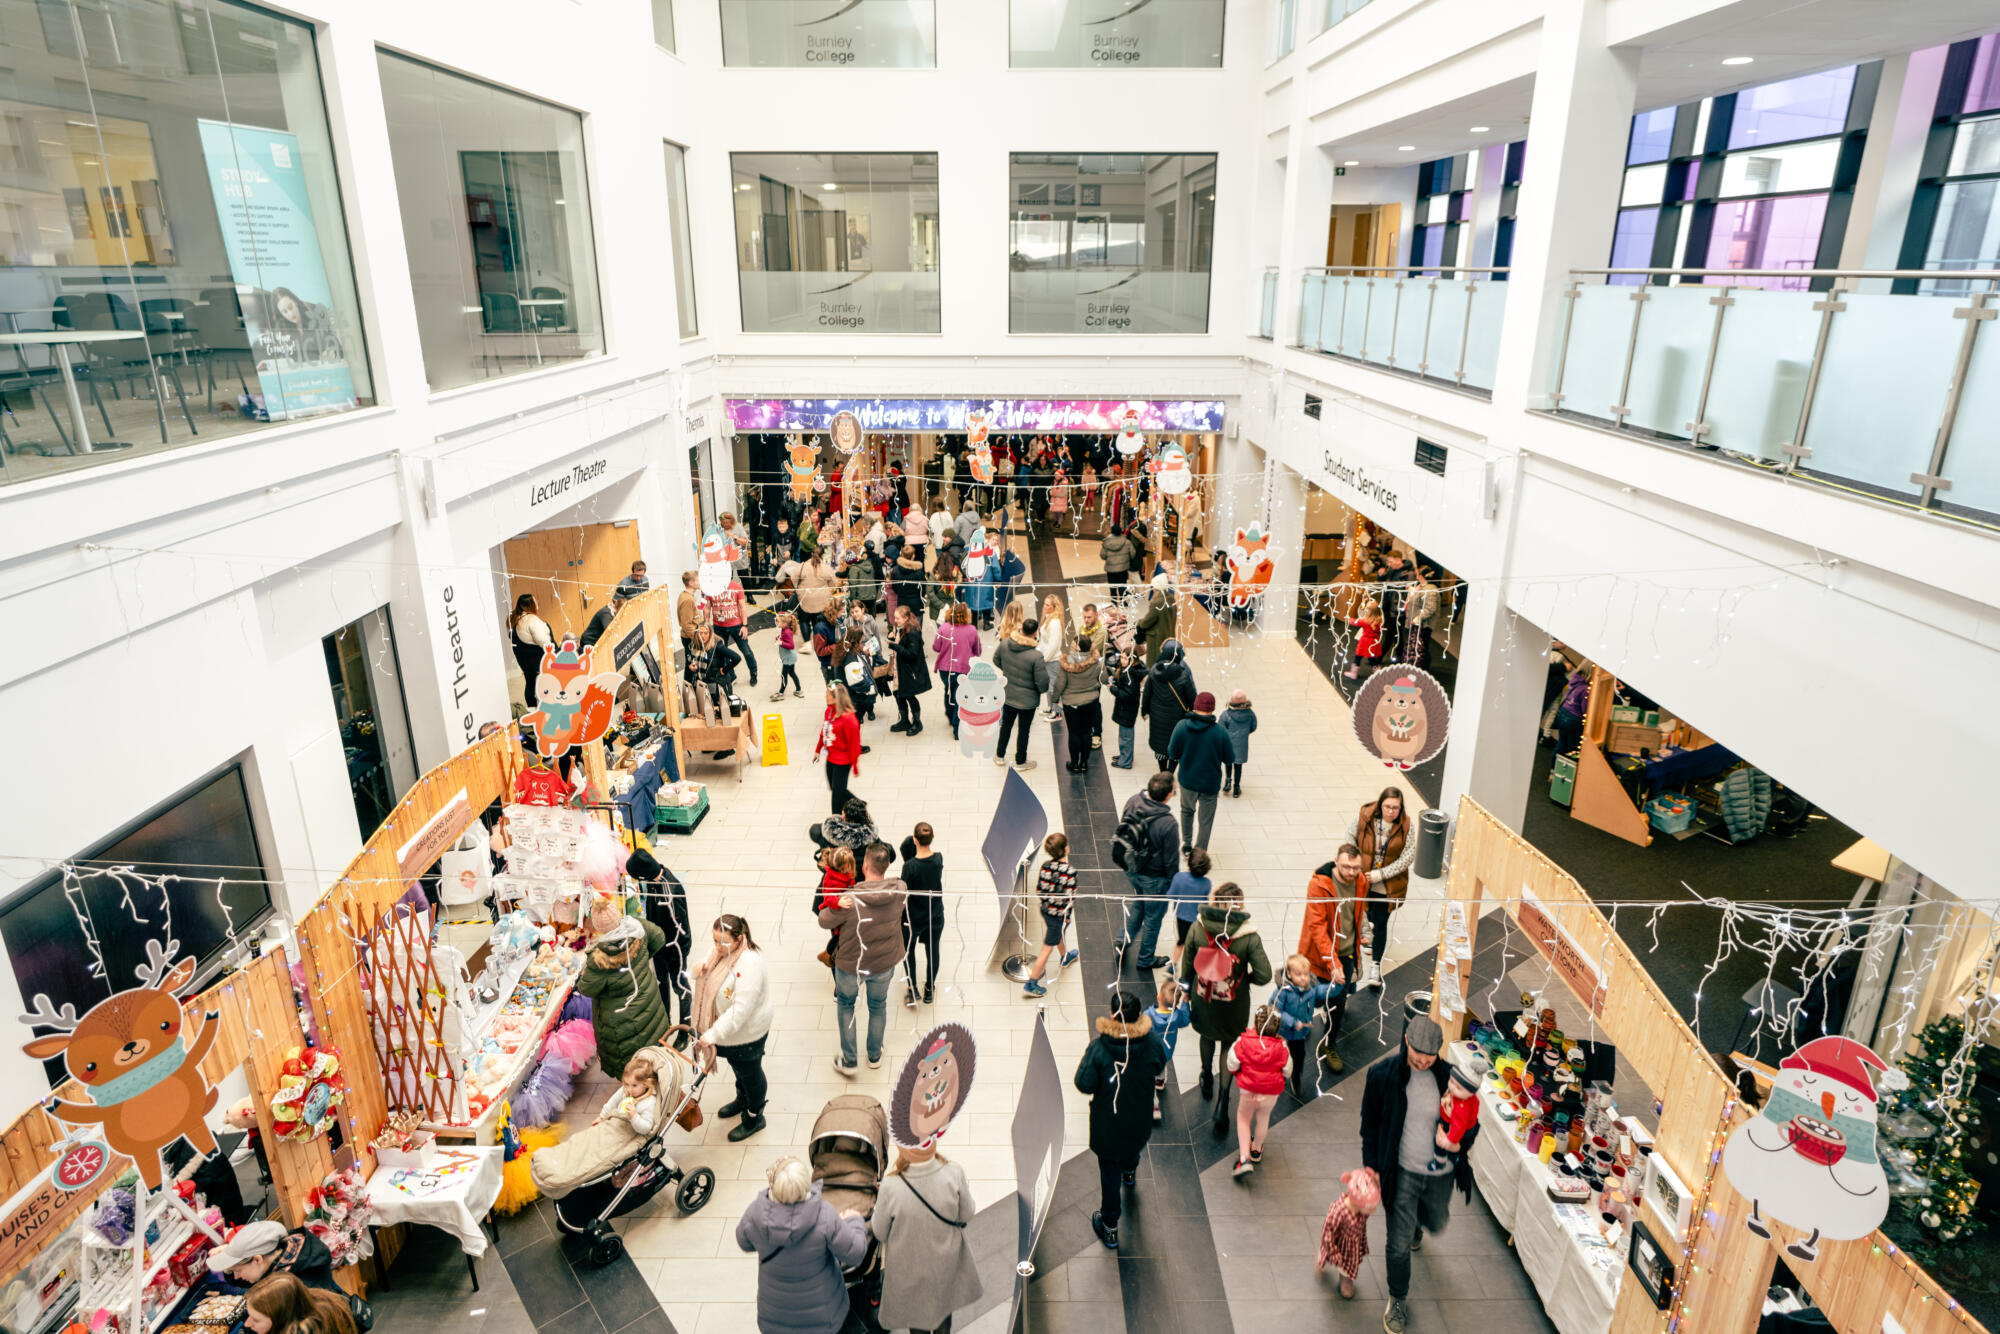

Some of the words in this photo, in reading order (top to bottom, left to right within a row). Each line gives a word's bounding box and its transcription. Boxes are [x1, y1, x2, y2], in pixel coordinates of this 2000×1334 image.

[807, 34, 853, 49] Burnley
[1094, 34, 1140, 49] Burnley
[805, 50, 855, 65] College
[1091, 49, 1141, 64] College
[820, 302, 862, 314] Burnley
[1087, 302, 1130, 315] Burnley
[818, 315, 865, 328] College
[1085, 315, 1131, 329] College
[854, 402, 921, 427] Welcome
[926, 407, 941, 424] to
[1007, 402, 1100, 428] Wonderland
[531, 474, 571, 507] Lecture
[573, 459, 606, 486] Theatre
[1323, 450, 1355, 488] Student
[1357, 467, 1397, 511] Services
[443, 585, 469, 710] Theatre
[15, 1209, 50, 1248] AND
